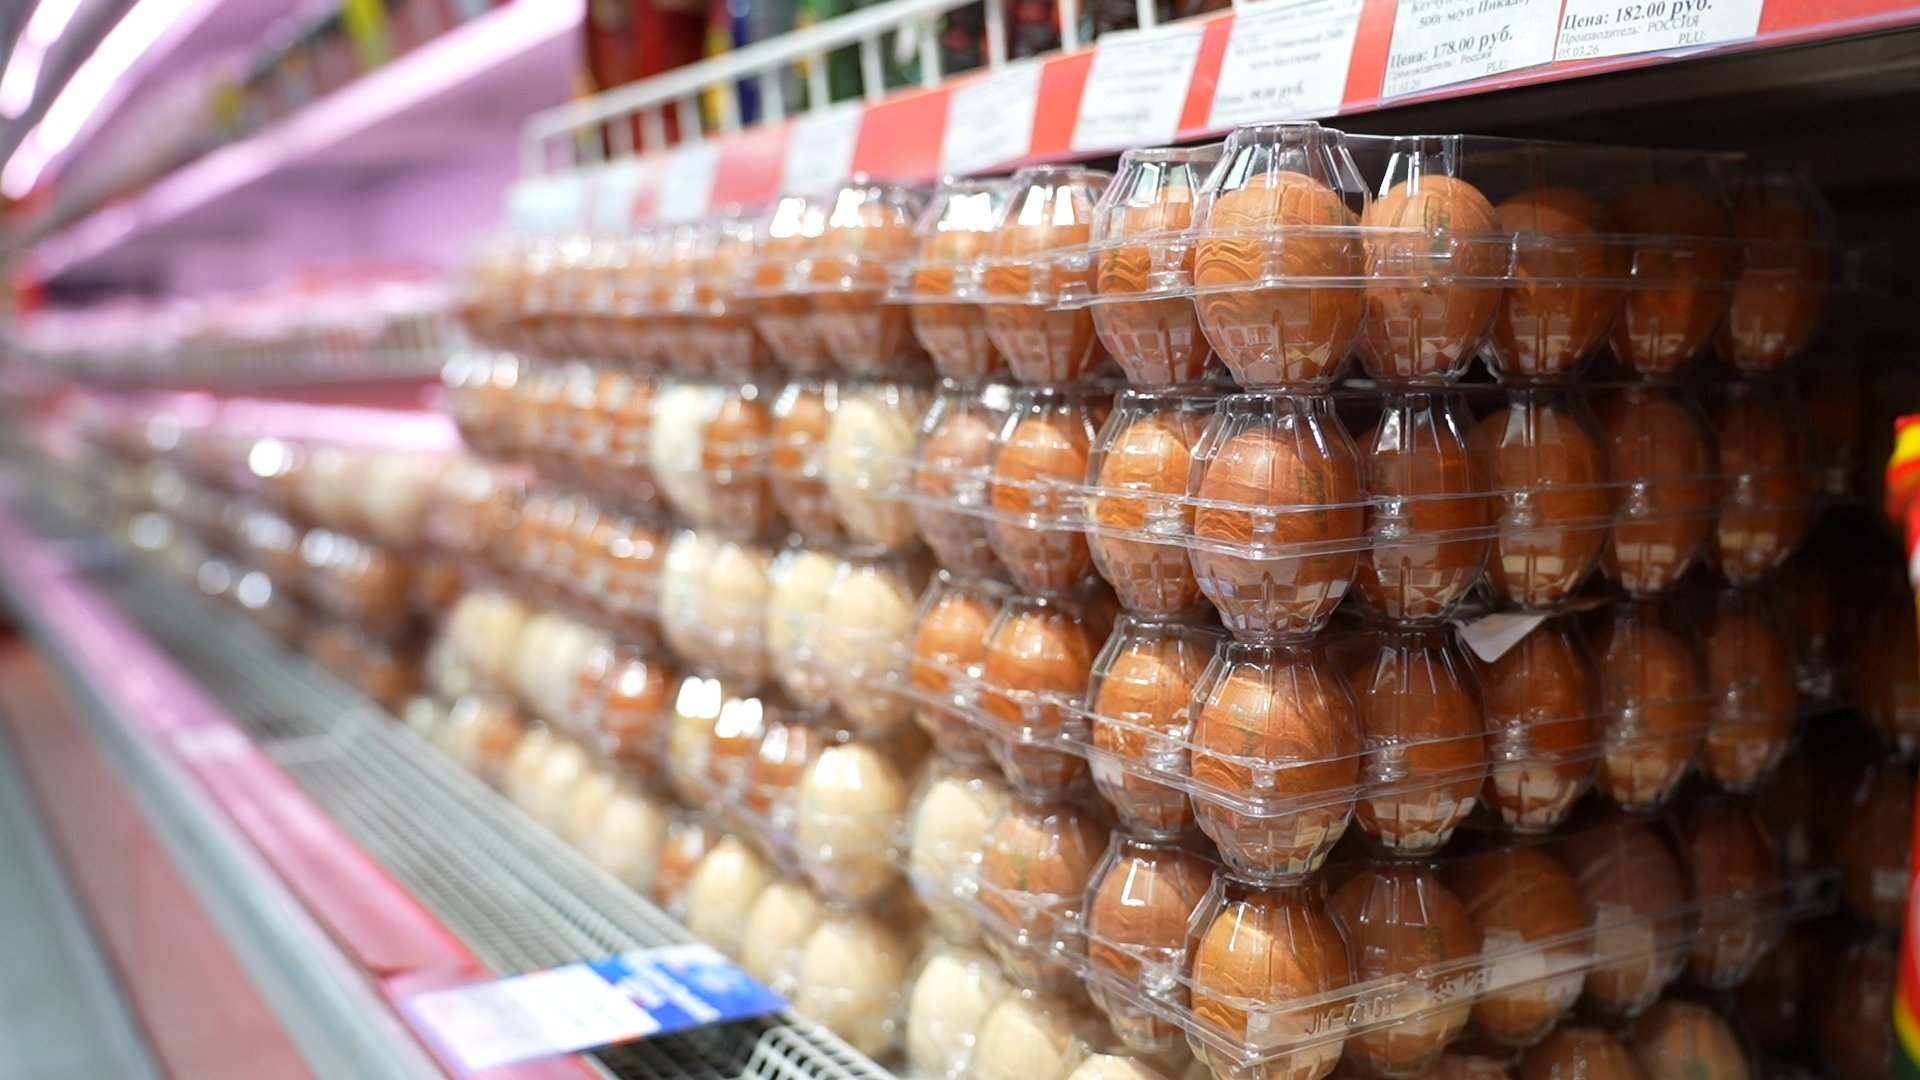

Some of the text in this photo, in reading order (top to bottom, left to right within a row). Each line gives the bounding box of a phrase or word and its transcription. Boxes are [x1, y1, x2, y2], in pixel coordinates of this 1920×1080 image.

[1561, 15, 1699, 45] Производитель: РОССИЯ
[1565, 13, 1609, 30] Цена:
[1615, 1, 1665, 23] 182.00
[1390, 25, 1513, 69] Цена: 178.00 руб.
[1558, 45, 1599, 59] 05.03.26
[1678, 31, 1707, 44] PLU:
